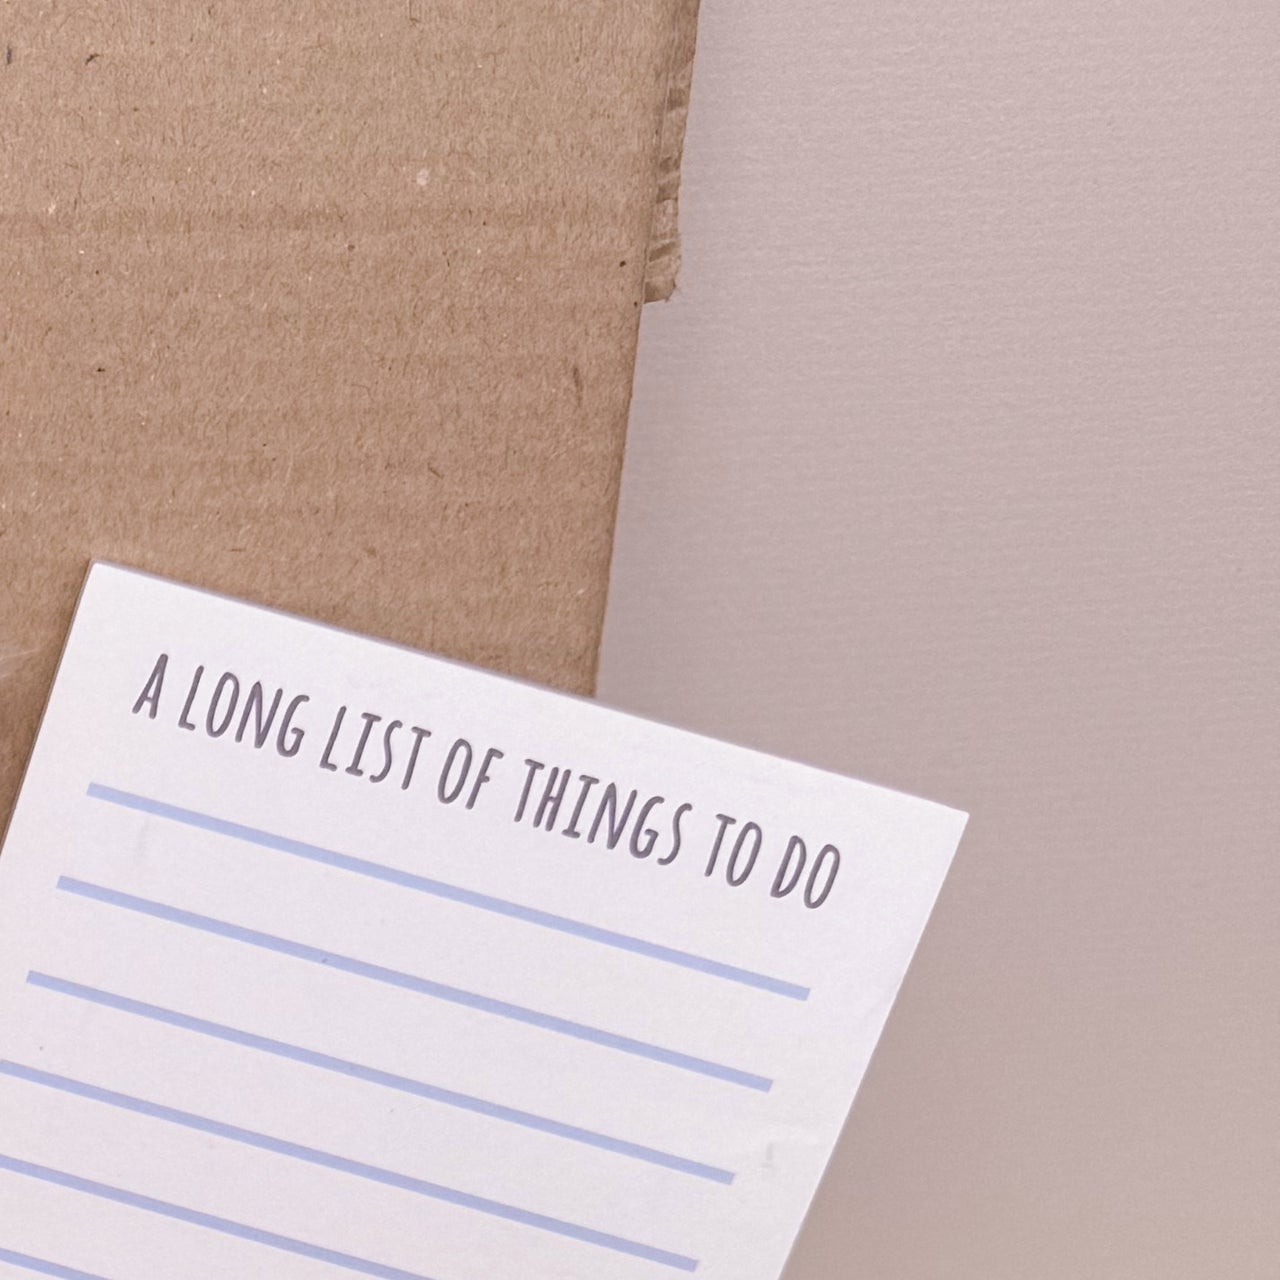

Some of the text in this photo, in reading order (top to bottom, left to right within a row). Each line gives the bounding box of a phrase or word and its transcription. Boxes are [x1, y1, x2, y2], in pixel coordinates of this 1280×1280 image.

[132, 653, 841, 909] A LONG LIST OF THINGS TO DO
